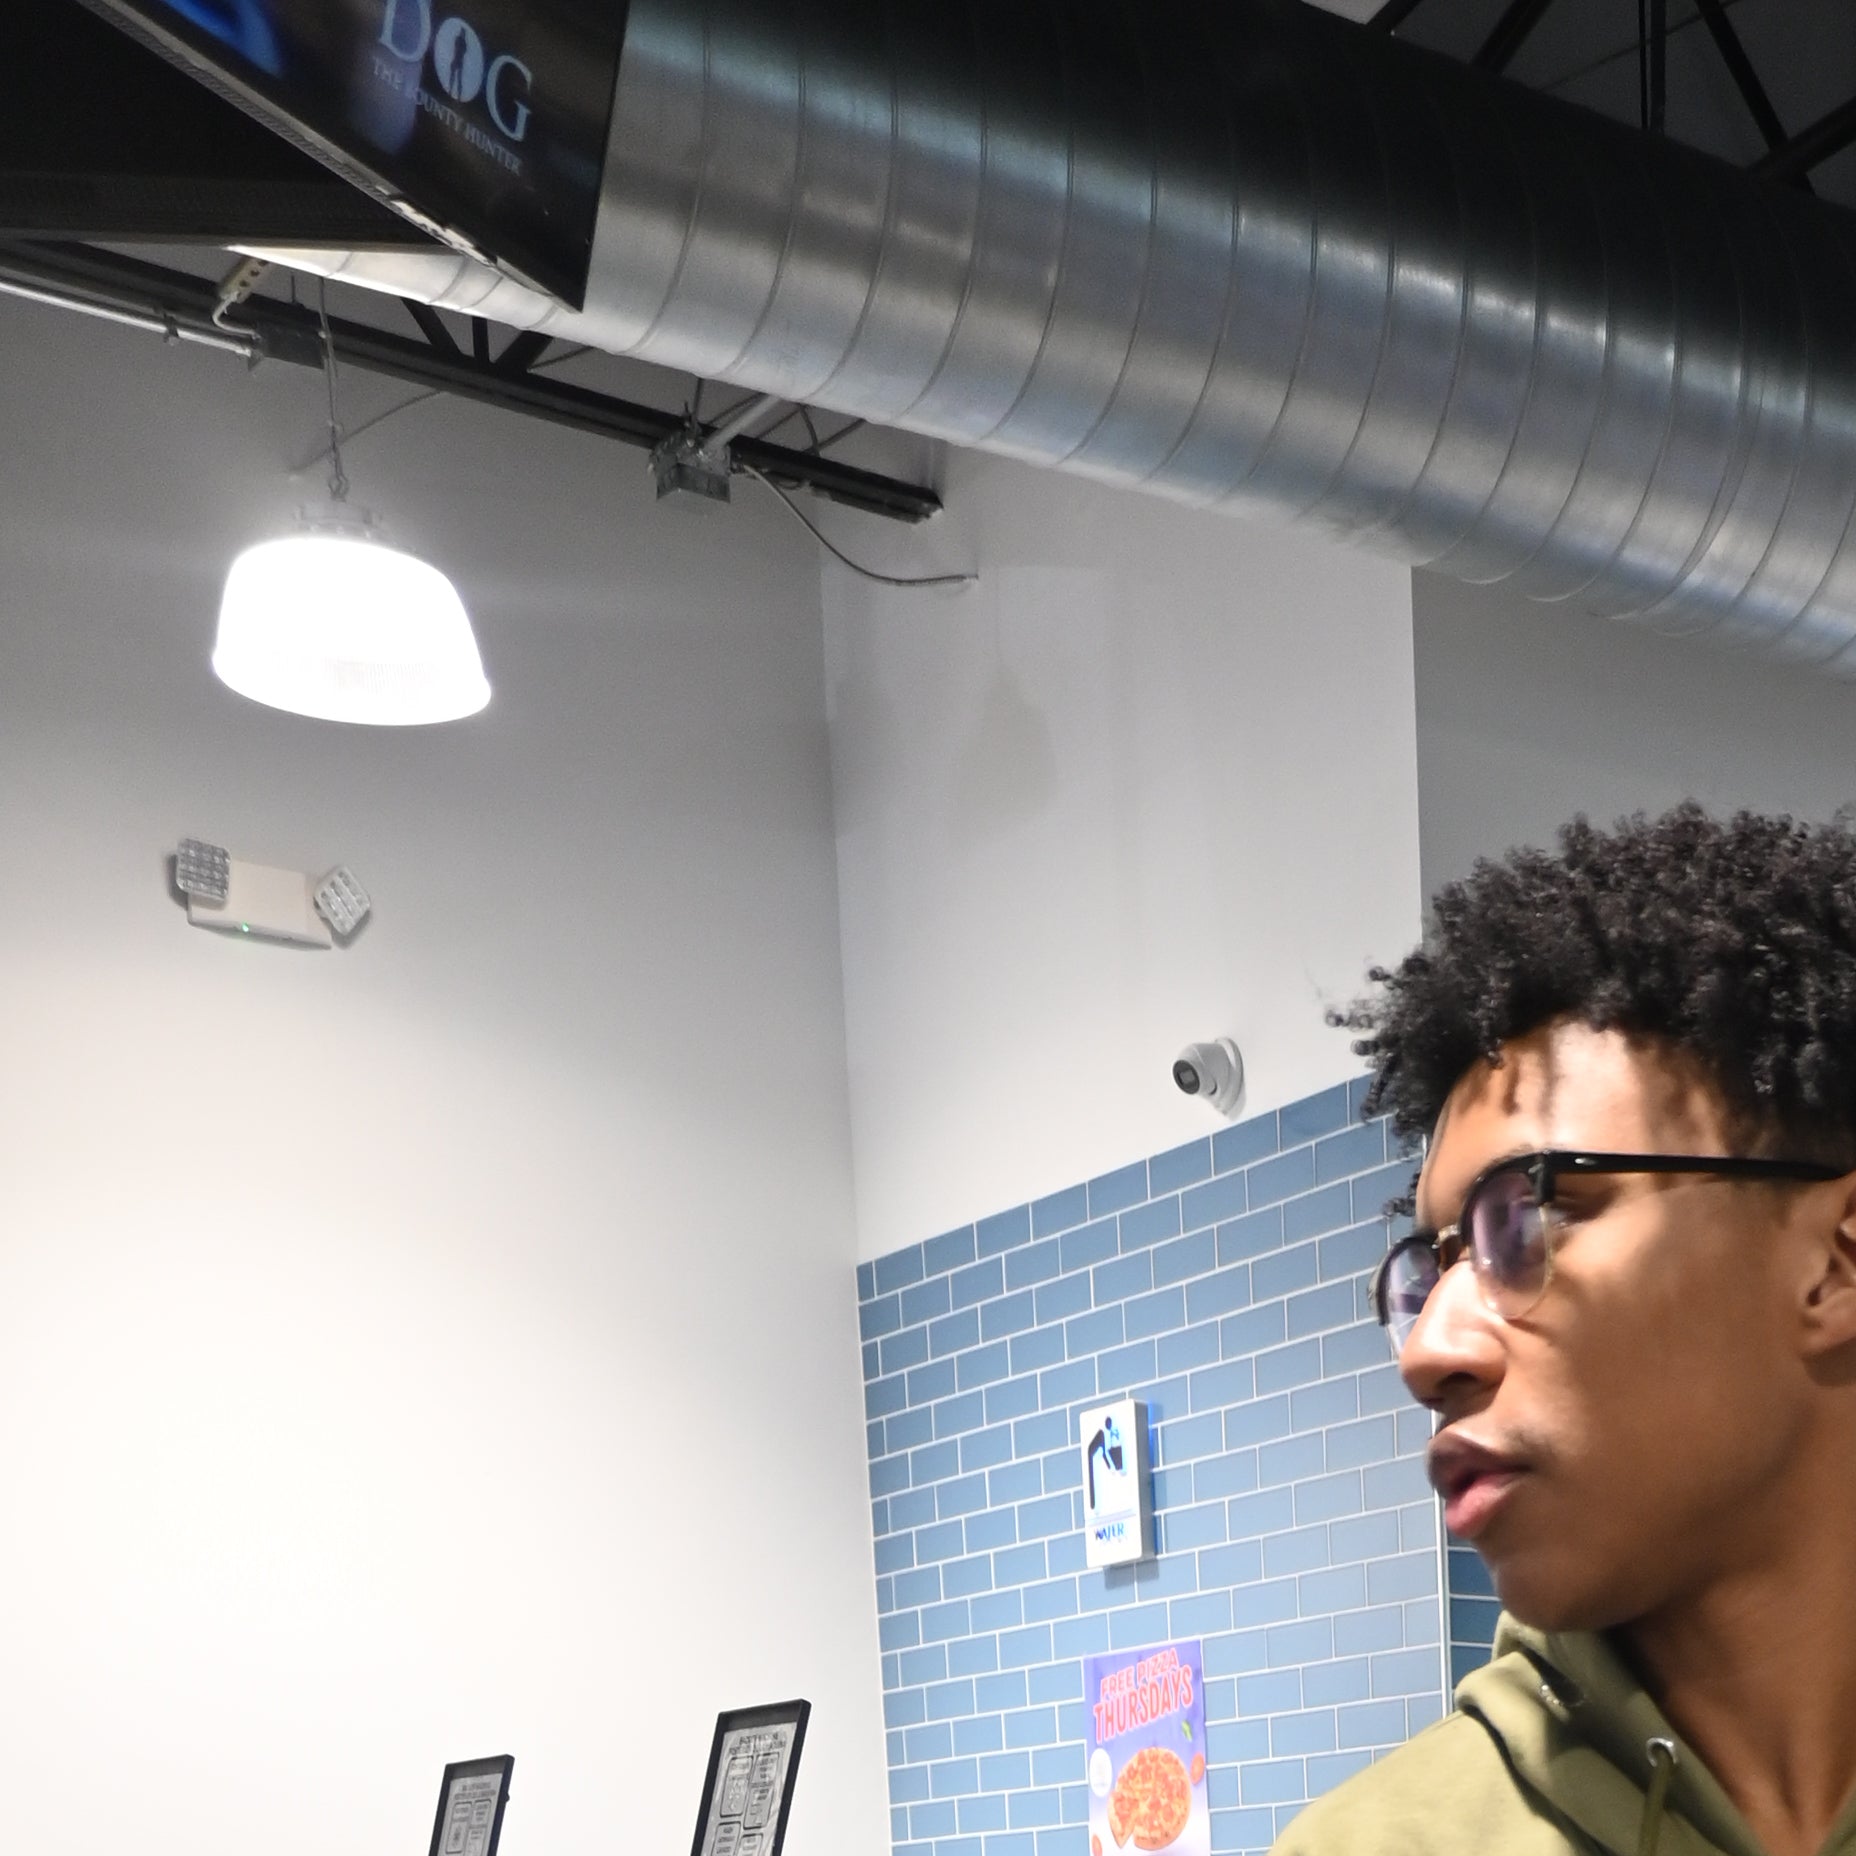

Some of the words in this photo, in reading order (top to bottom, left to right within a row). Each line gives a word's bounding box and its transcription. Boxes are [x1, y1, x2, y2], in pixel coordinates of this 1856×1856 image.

[378, 0, 533, 142] DOG
[1093, 1664, 1193, 1745] THURSDAYS
[1101, 1665, 1135, 1700] FREE
[1137, 1648, 1179, 1685] PIZZA
